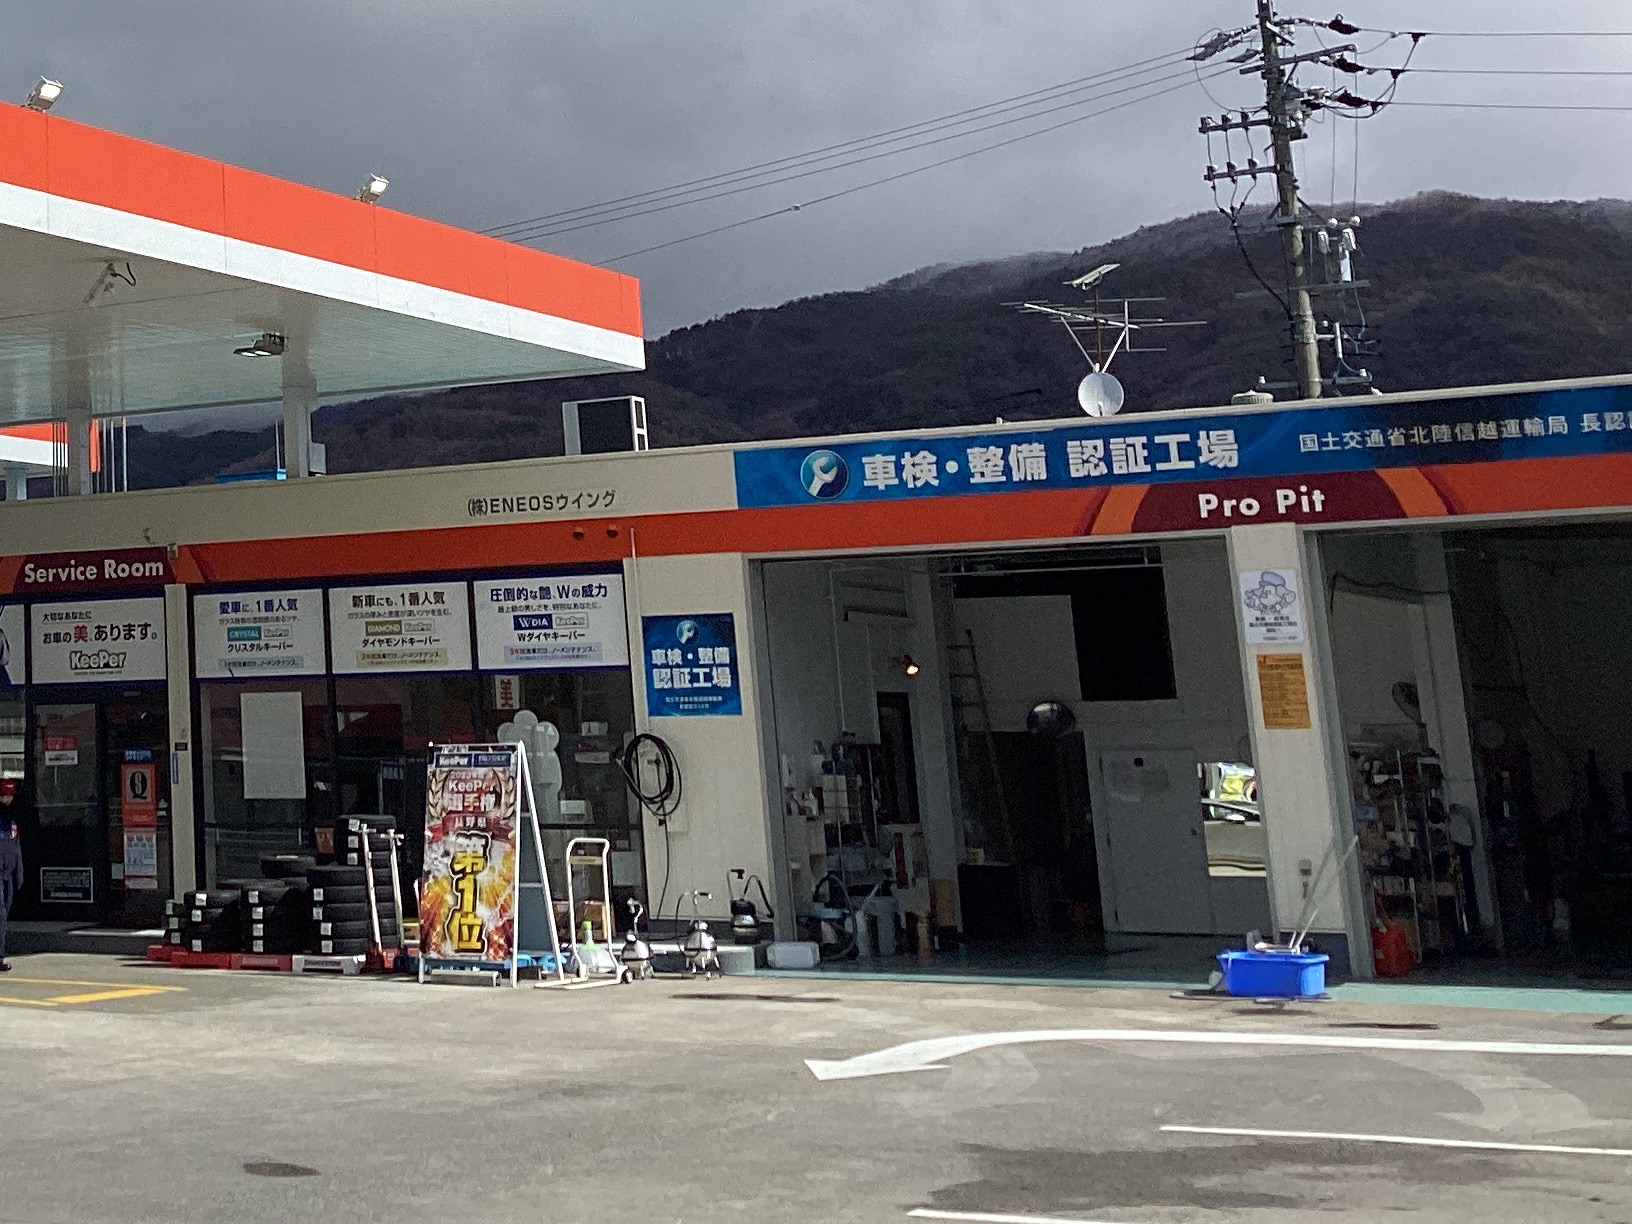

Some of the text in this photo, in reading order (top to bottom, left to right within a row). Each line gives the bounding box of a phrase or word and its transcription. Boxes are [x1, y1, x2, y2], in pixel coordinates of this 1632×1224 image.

[1299, 410, 1632, 453] 国土交通省北陸信越運輸局 長認
[862, 429, 1239, 491] 車検・整備 認証工場
[467, 489, 616, 517] (株)ENEOSウイング
[1198, 485, 1325, 518] Pro Pit
[24, 559, 164, 583] Service Room
[69, 649, 126, 669] KeePer
[652, 667, 731, 689] 認証工場
[447, 836, 485, 950] 第1位
